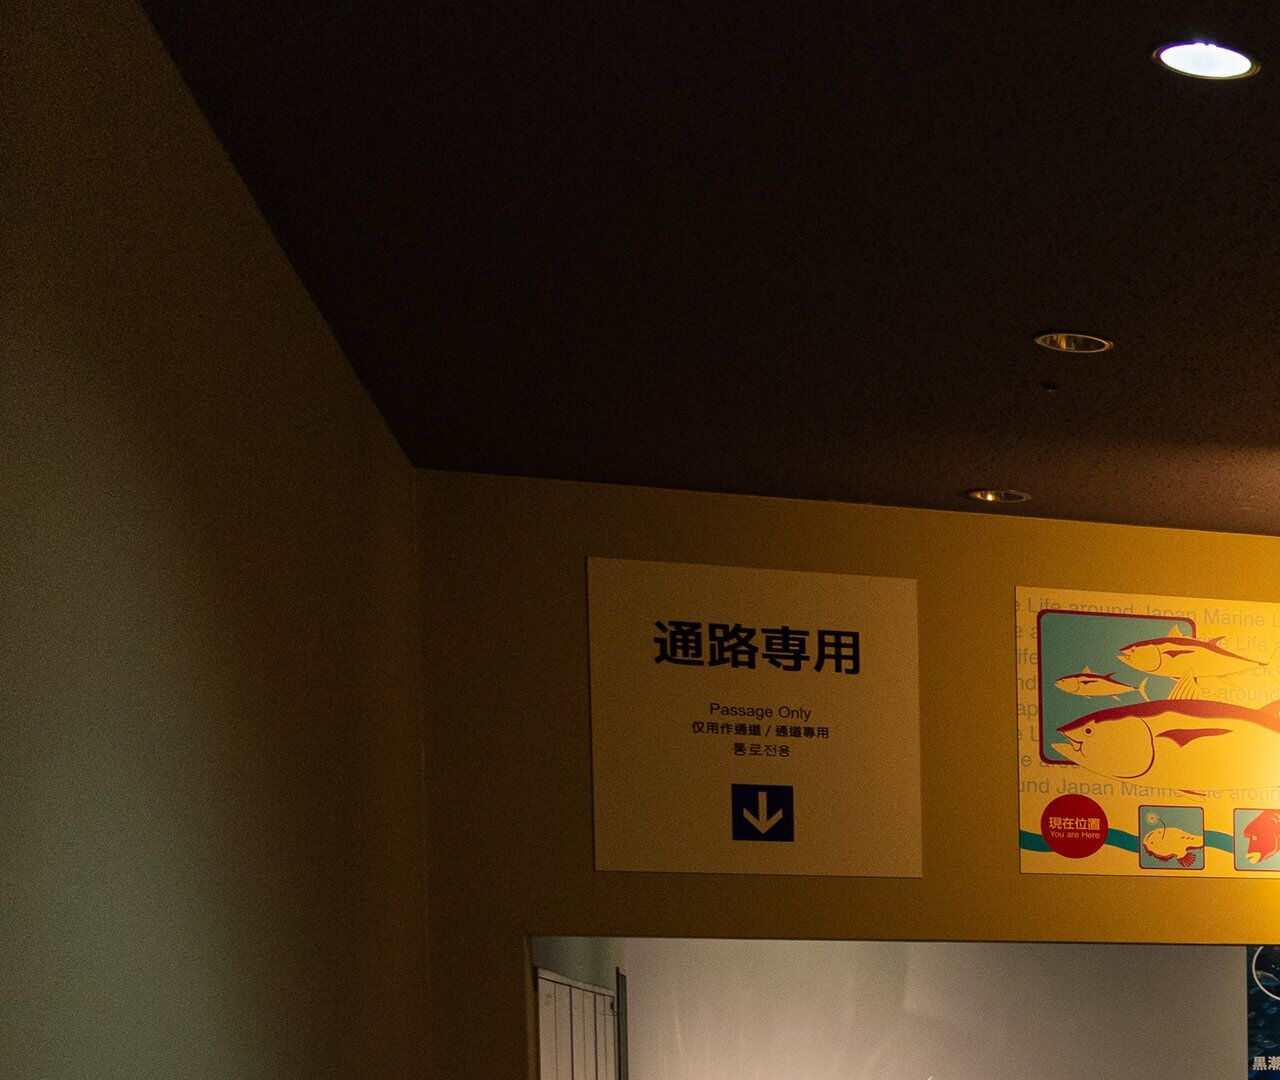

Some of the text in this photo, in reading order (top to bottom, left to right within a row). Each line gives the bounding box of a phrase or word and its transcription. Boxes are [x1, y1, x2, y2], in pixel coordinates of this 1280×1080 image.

[1203, 607, 1265, 627] Marine
[653, 620, 861, 675] 通路専用
[710, 703, 812, 721] Passage Only
[1049, 816, 1100, 830] 現在位置
